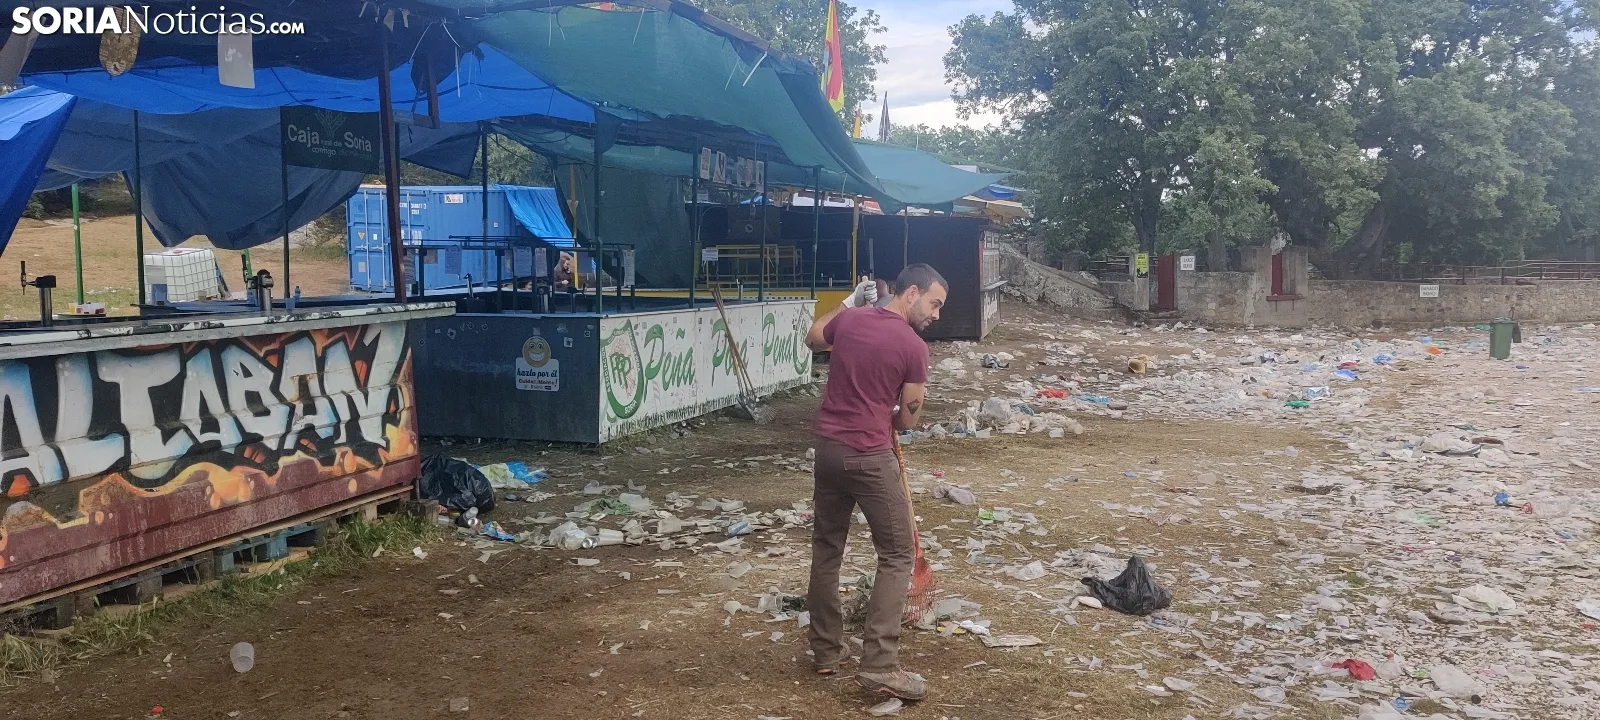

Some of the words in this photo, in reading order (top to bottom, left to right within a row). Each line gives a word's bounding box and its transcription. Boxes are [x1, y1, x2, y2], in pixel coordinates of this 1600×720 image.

[287, 124, 320, 148] Caja
[343, 131, 372, 152] Soria
[517, 368, 536, 377] hazlo
[536, 371, 550, 379] por
[643, 323, 696, 404] Peña
